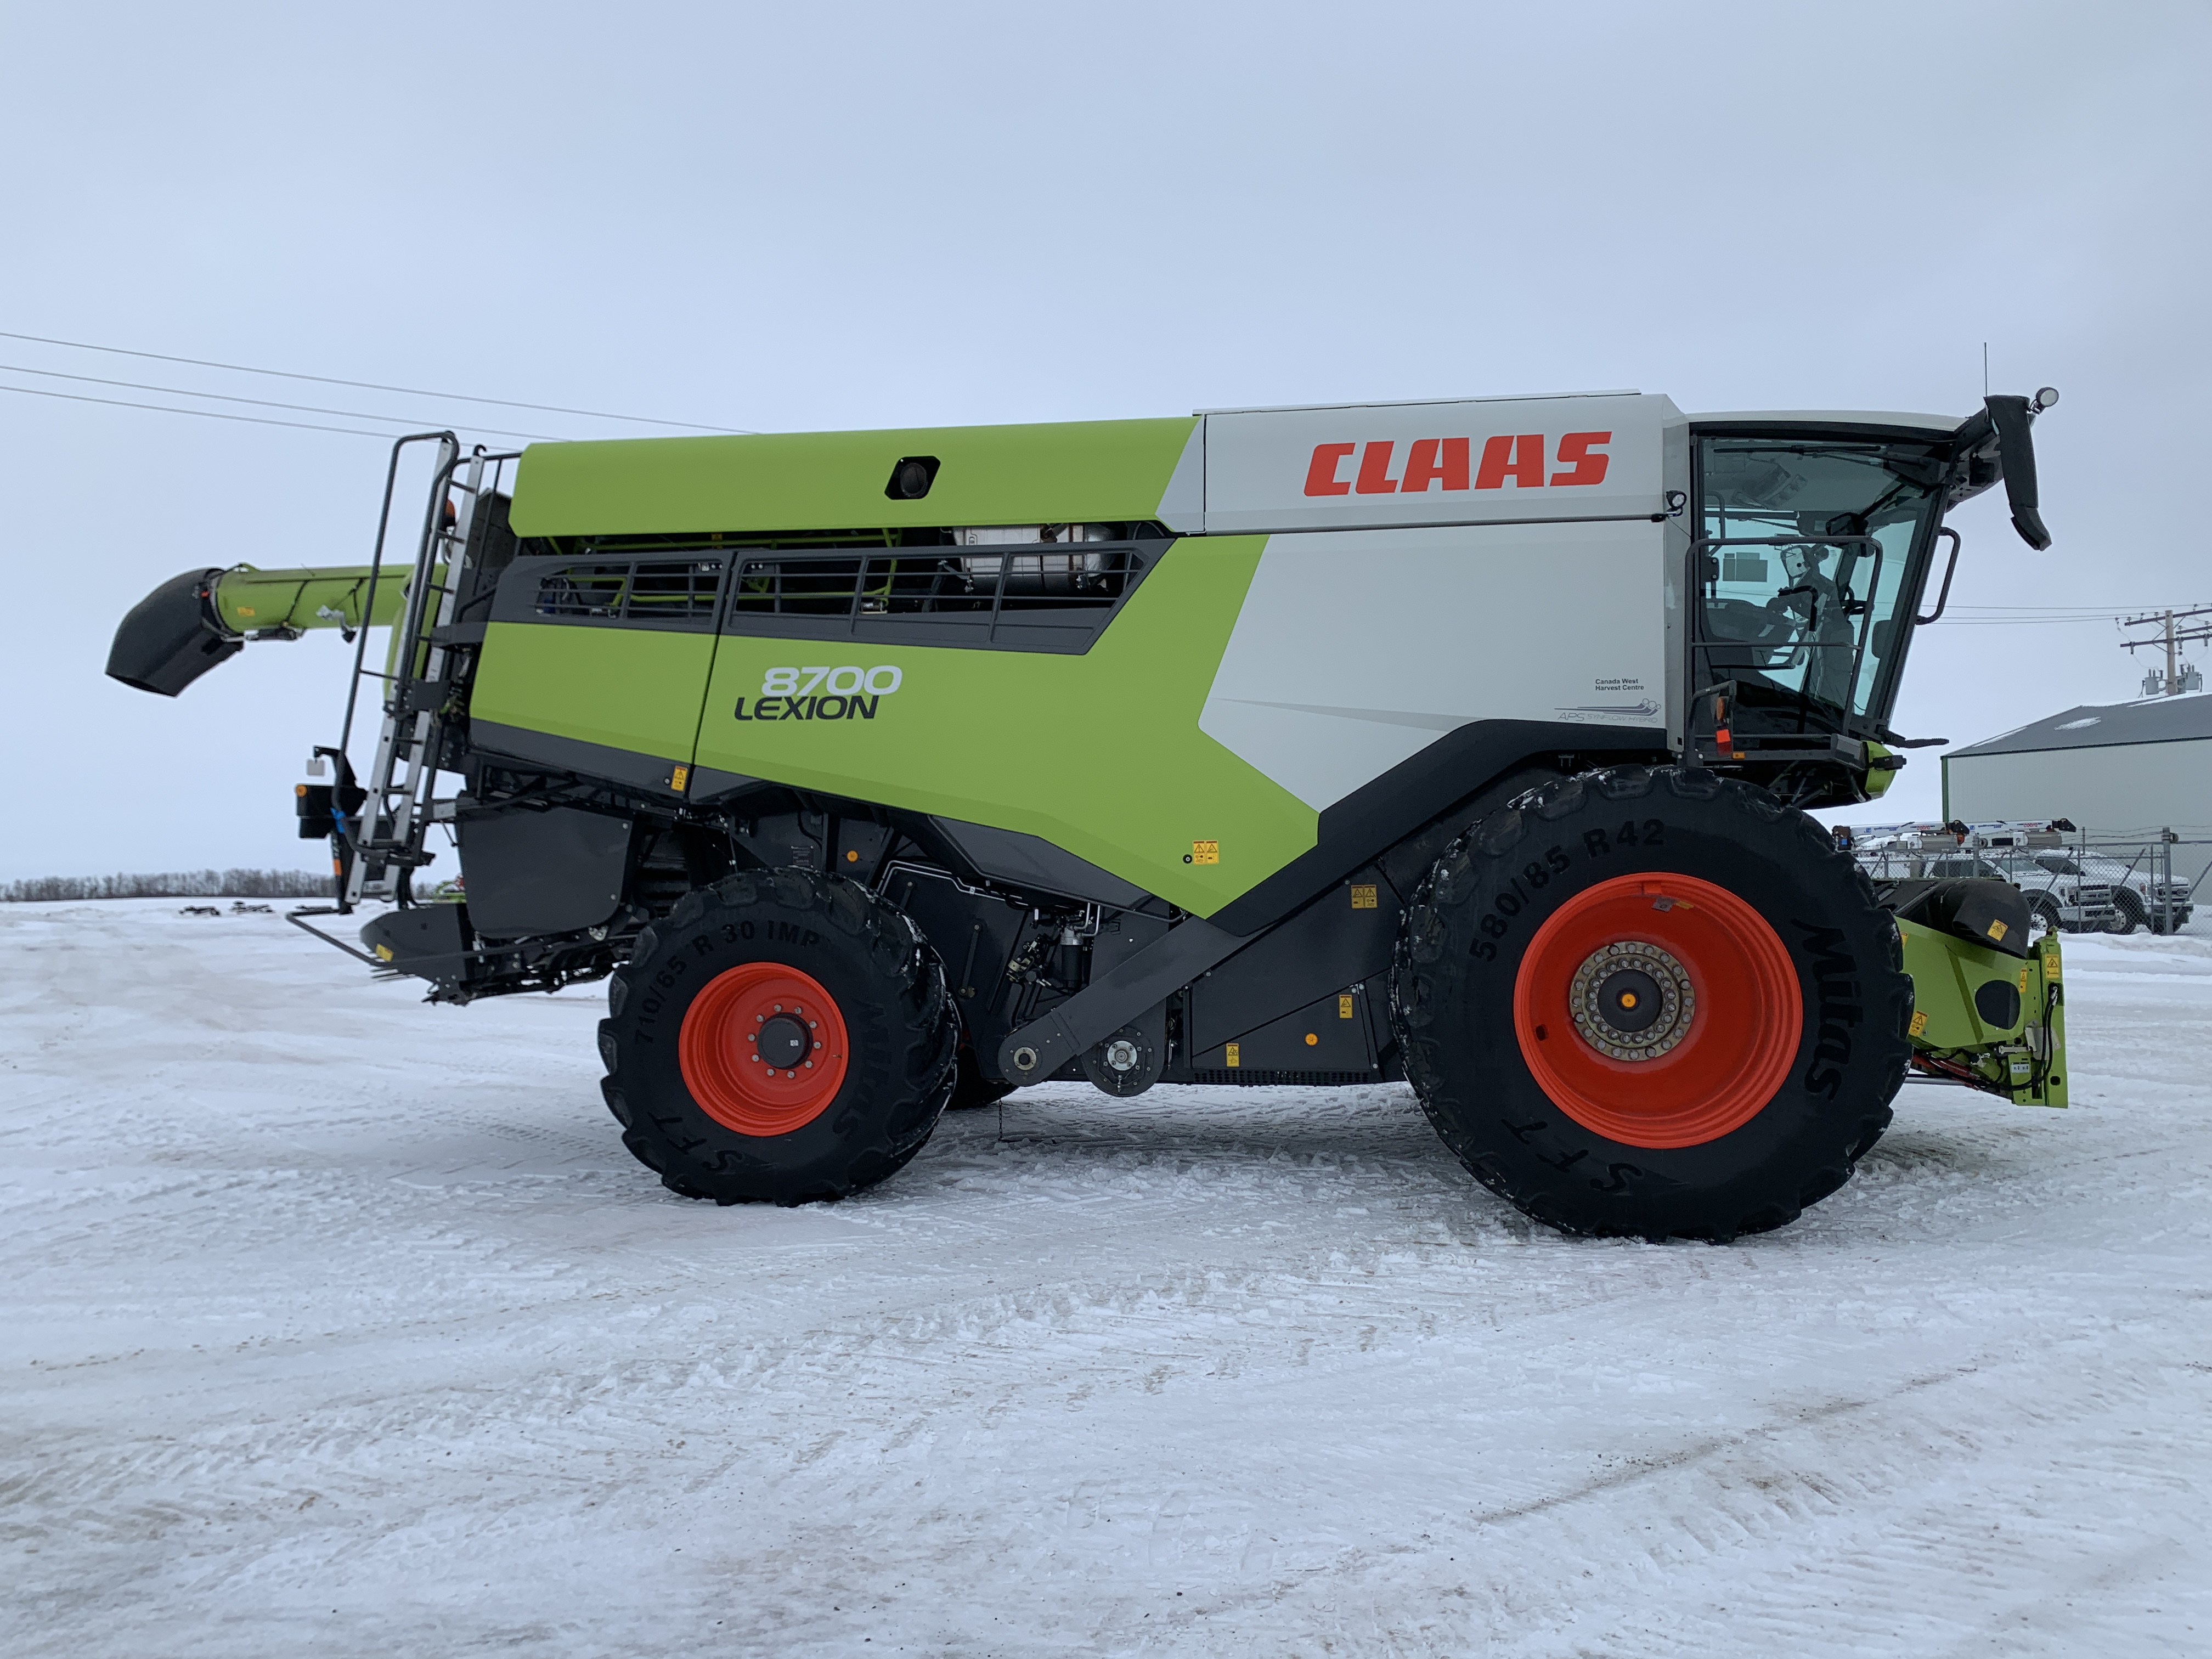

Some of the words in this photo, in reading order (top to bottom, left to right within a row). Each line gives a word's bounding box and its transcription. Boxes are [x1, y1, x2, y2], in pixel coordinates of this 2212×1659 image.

[1304, 431, 1612, 496] CLAAS
[734, 695, 879, 720] LEXION
[761, 665, 902, 697] 8700
[1558, 712, 1585, 721] APS
[1469, 845, 1571, 963] 580/85
[635, 956, 687, 1043] 710/65
[693, 934, 714, 956] R
[721, 921, 755, 944] 30
[767, 921, 820, 947] IMP
[1791, 917, 1863, 1101] Mitas
